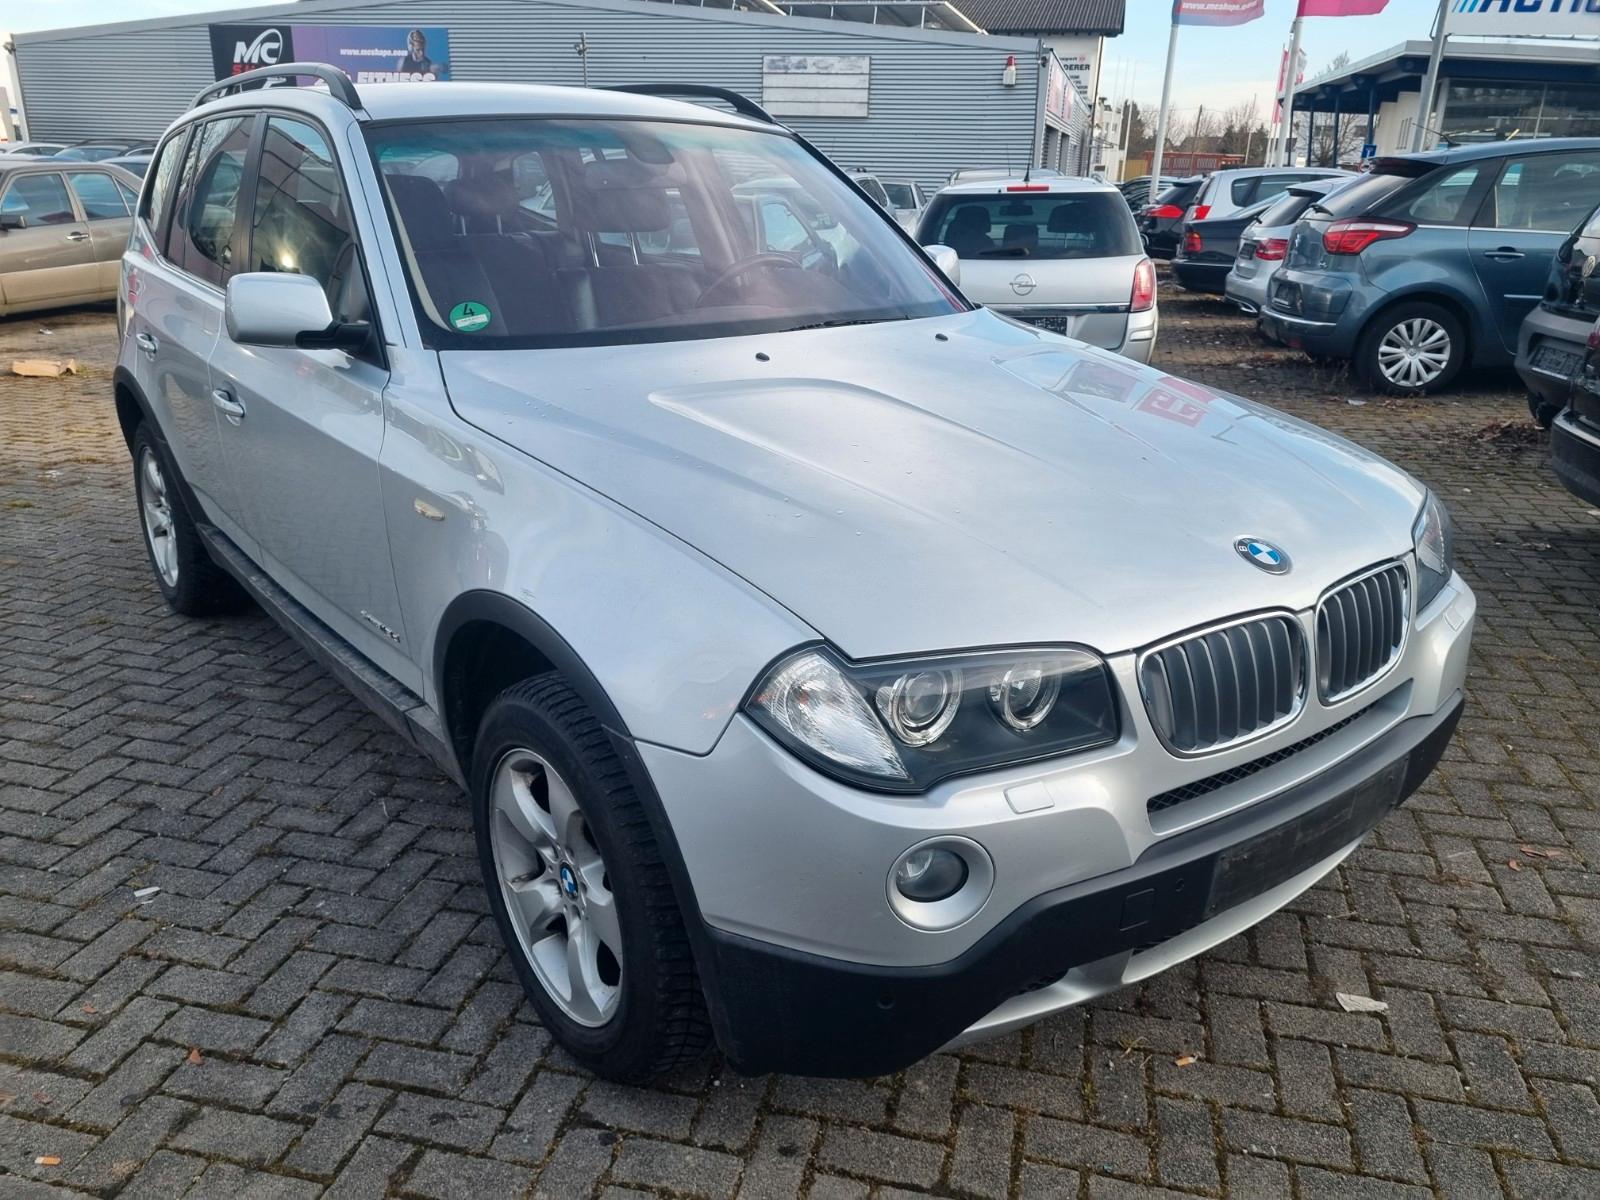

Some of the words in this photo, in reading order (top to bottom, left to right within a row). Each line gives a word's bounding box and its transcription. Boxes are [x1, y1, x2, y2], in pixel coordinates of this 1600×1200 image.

[233, 41, 280, 64] MC
[340, 48, 409, 58] www.mcshape.com
[463, 304, 475, 316] 4
